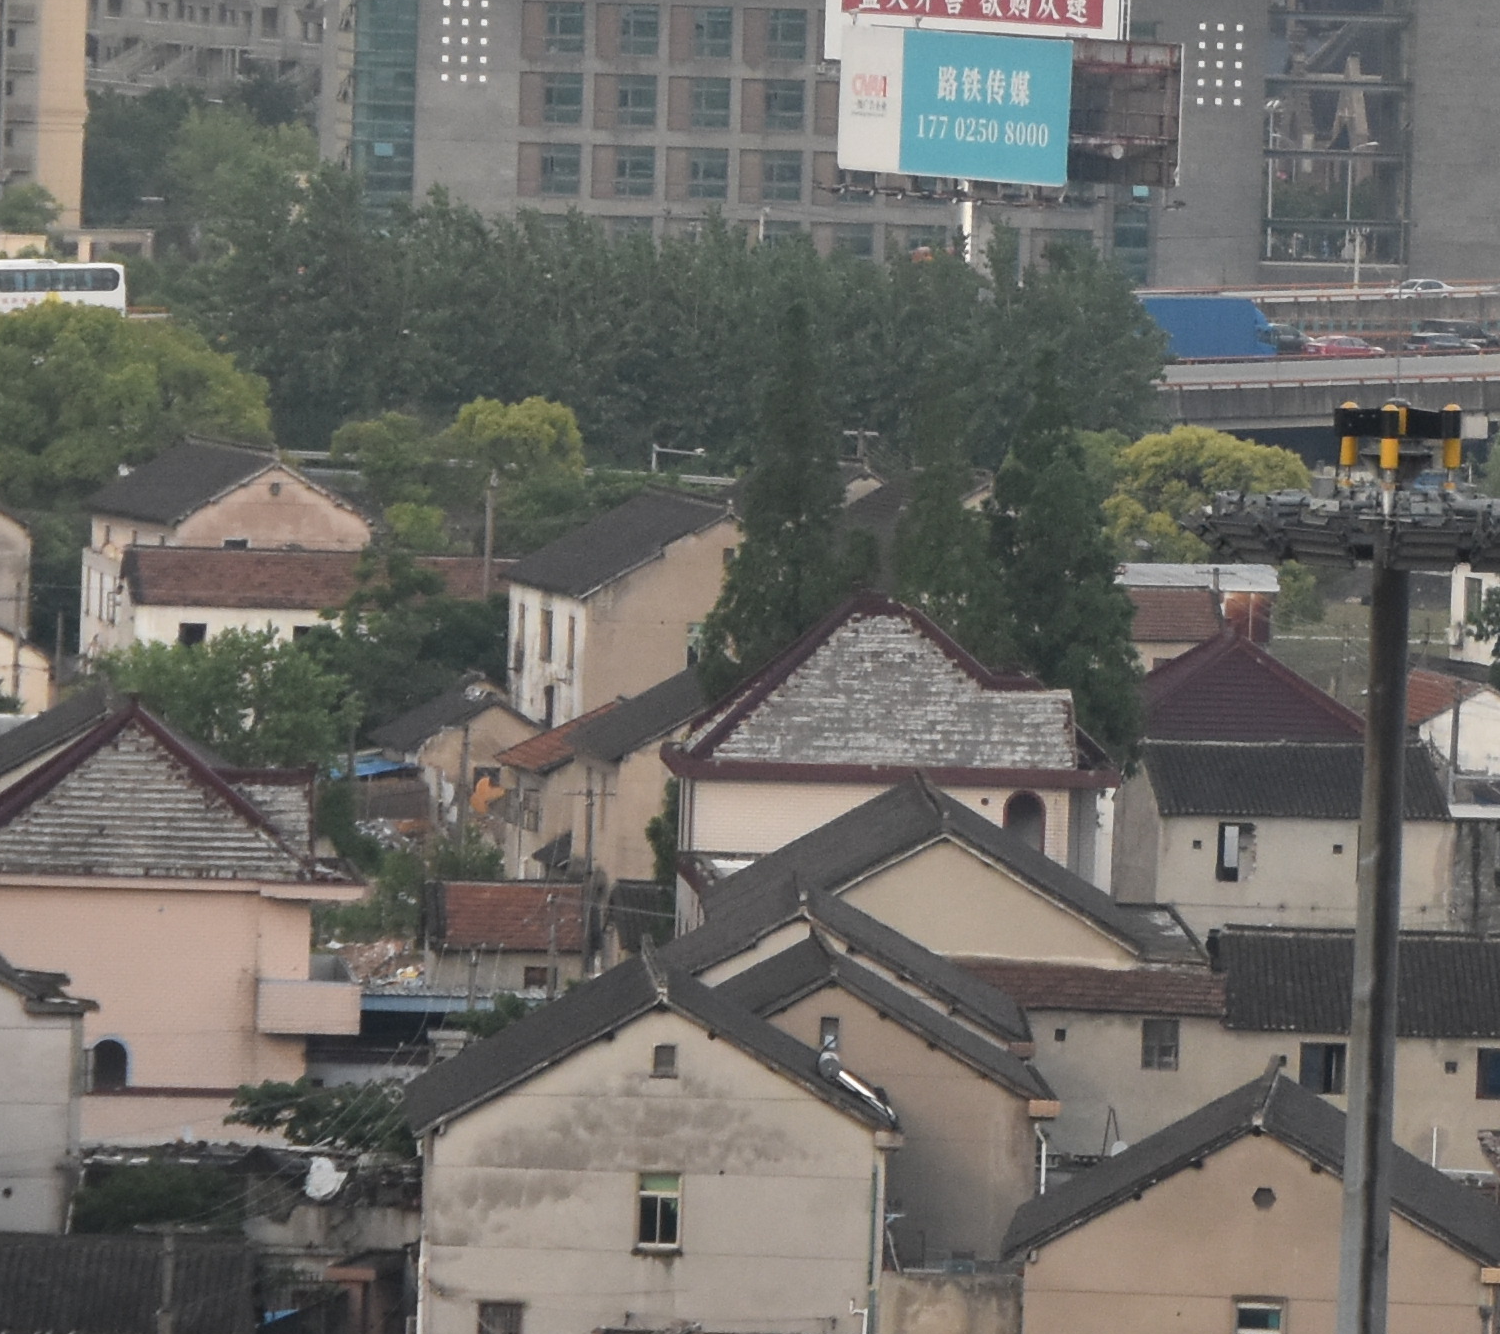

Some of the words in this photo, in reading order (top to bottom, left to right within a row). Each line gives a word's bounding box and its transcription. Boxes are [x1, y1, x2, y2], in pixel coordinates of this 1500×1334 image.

[937, 65, 1031, 107] 路铁传媒
[917, 114, 949, 140] 177
[954, 117, 999, 143] 0250
[1004, 120, 1049, 148] 8000
